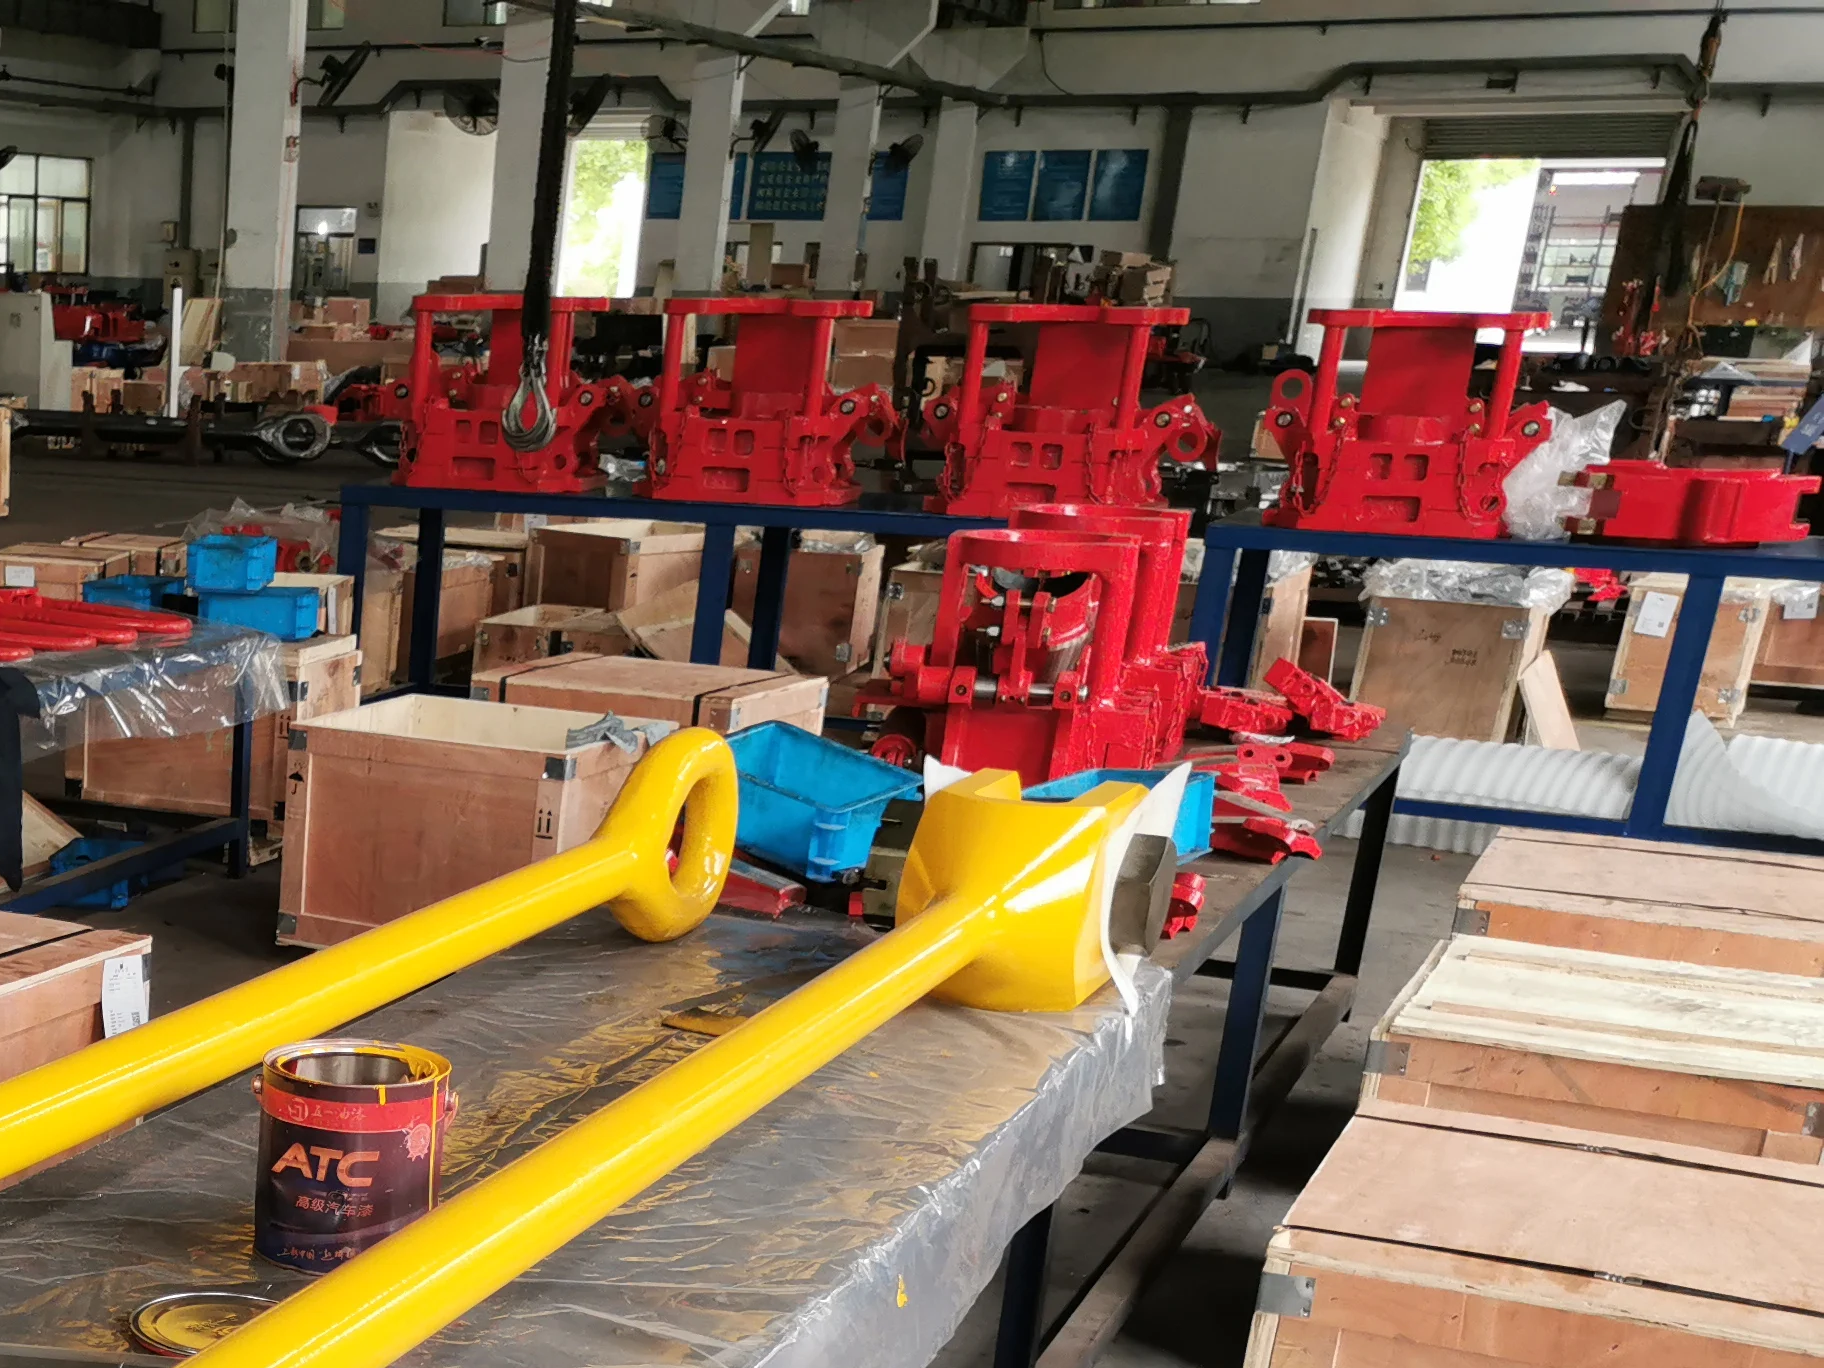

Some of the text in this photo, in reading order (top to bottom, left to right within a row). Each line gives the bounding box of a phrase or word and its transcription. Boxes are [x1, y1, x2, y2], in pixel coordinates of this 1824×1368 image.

[271, 1143, 380, 1187] ATC
[295, 1195, 374, 1218] 高级汽车漆
